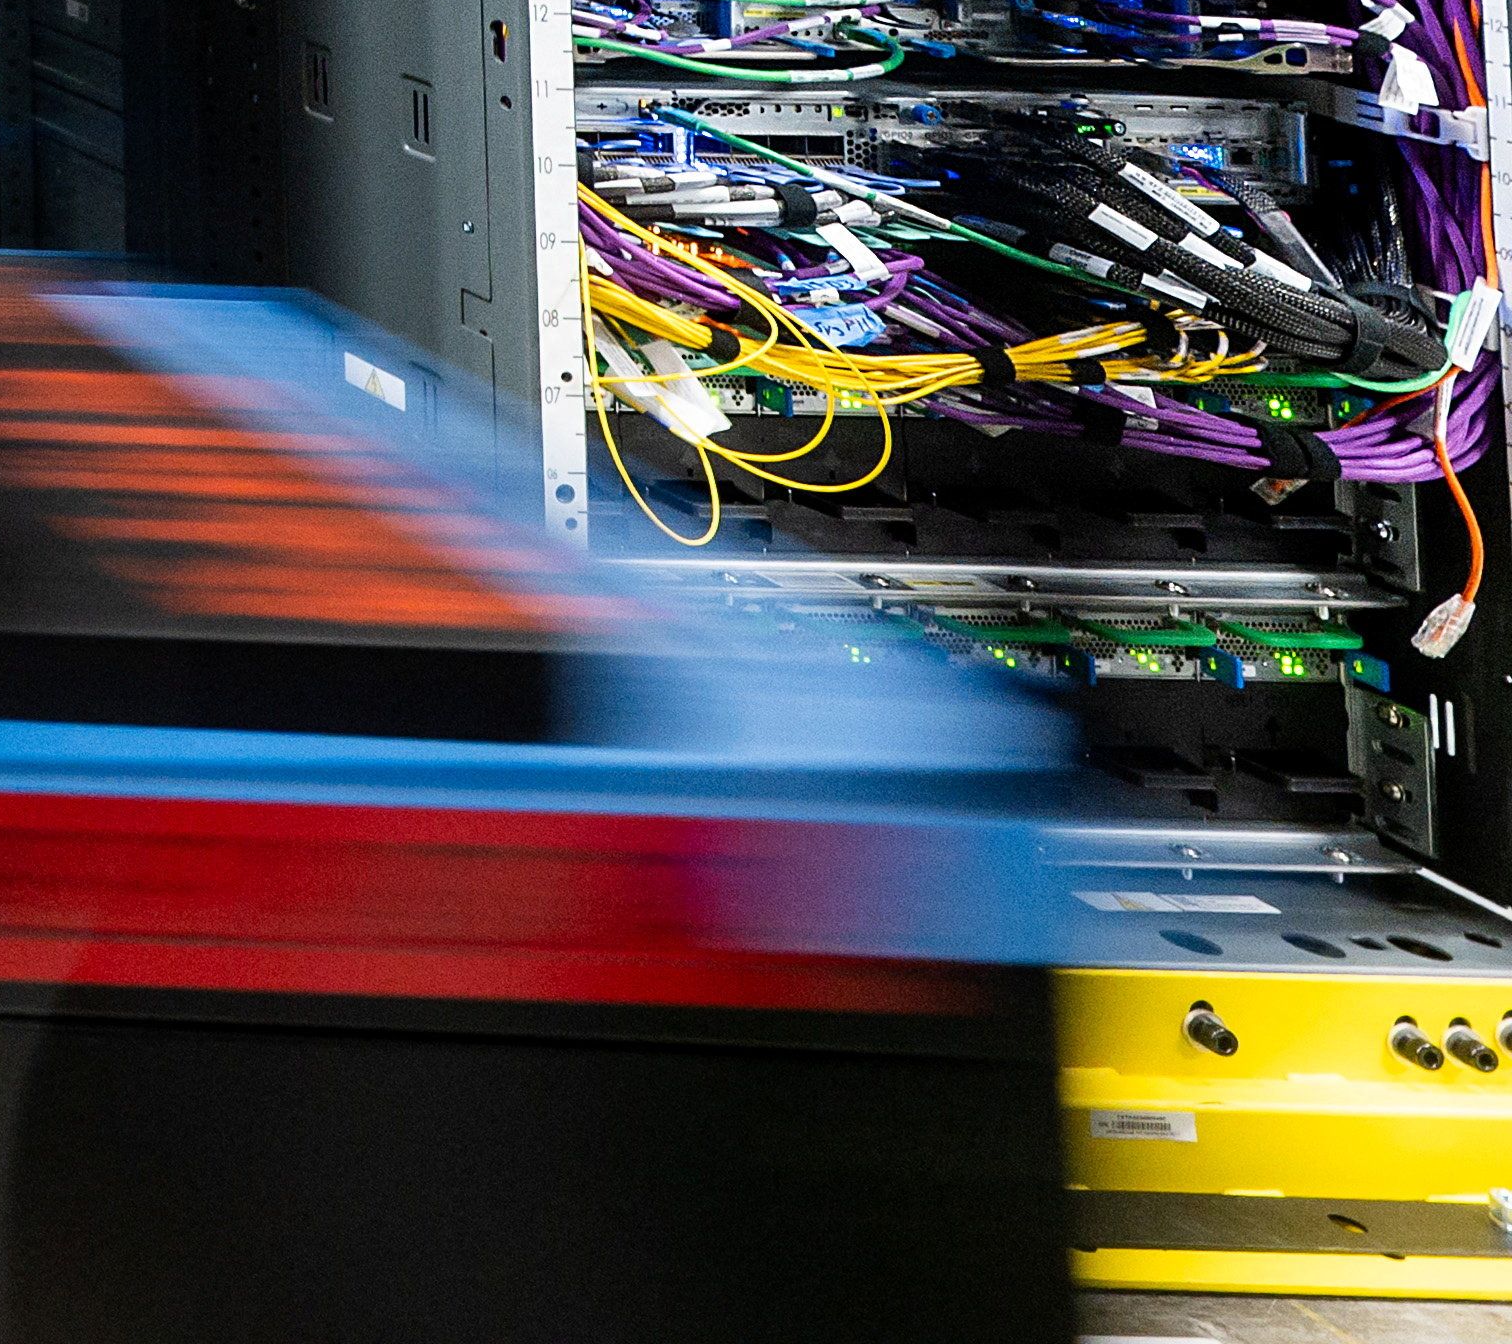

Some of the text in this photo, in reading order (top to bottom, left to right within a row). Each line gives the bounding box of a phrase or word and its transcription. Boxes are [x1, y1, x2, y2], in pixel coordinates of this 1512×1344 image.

[534, 5, 547, 22] 12
[535, 81, 549, 97] 11
[538, 157, 552, 173] 10
[541, 233, 555, 249] 09
[543, 311, 557, 327] 08
[546, 388, 560, 404] 07
